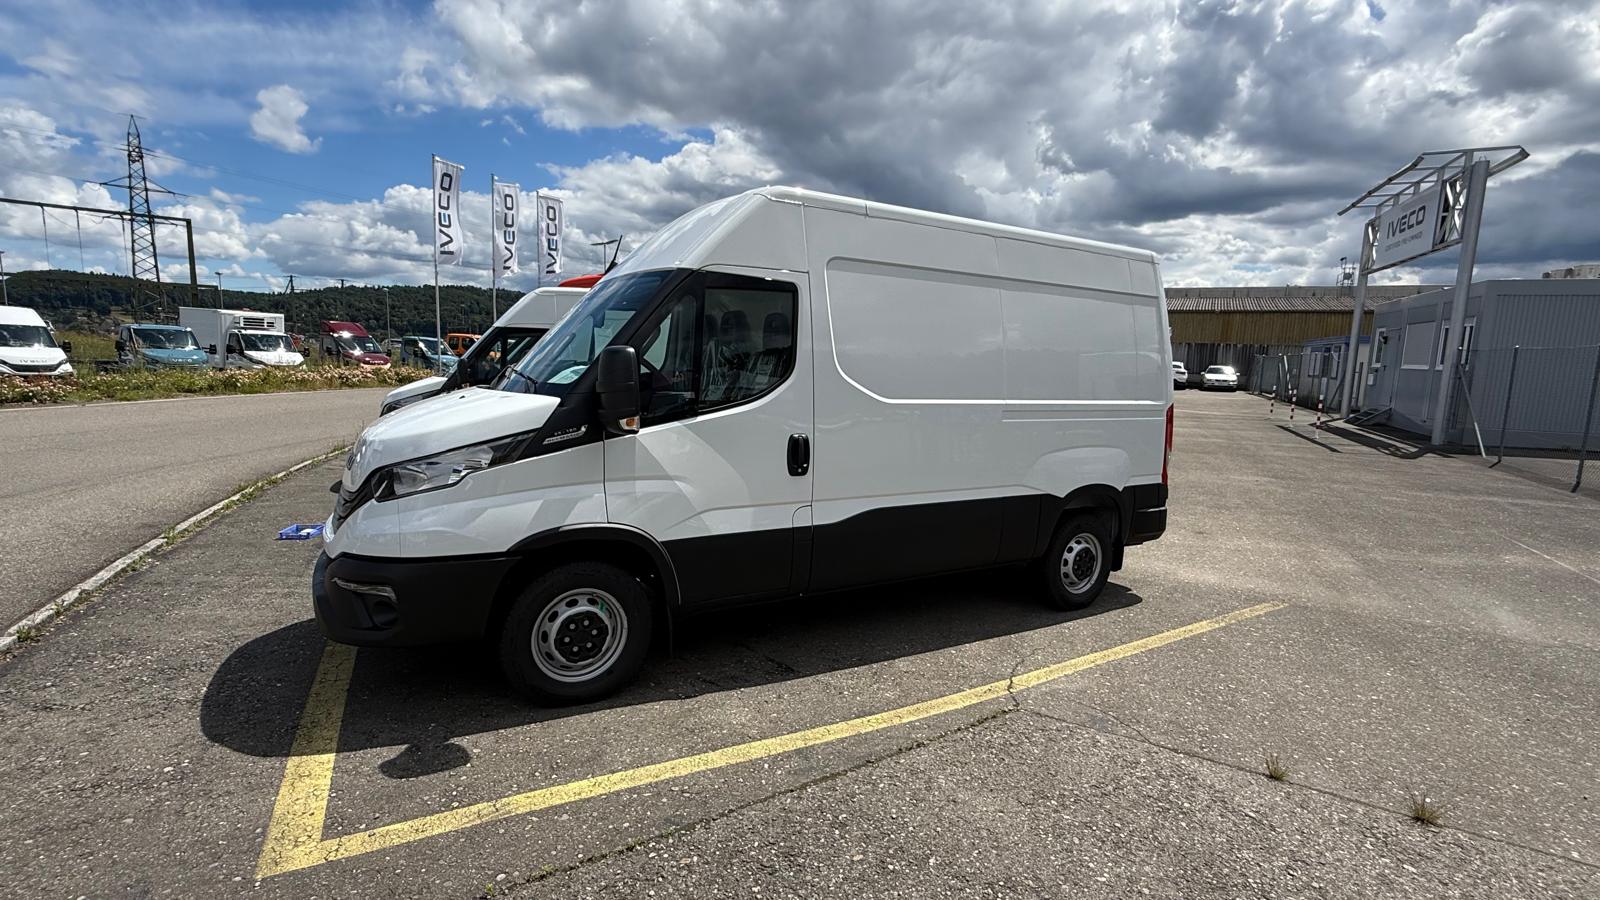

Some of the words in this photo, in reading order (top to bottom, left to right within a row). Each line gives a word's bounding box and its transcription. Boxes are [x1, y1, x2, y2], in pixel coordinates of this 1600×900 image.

[438, 172, 455, 256] IVECO
[503, 193, 516, 271] IVECO
[545, 205, 557, 275] IVECO
[1386, 204, 1426, 240] IVECO
